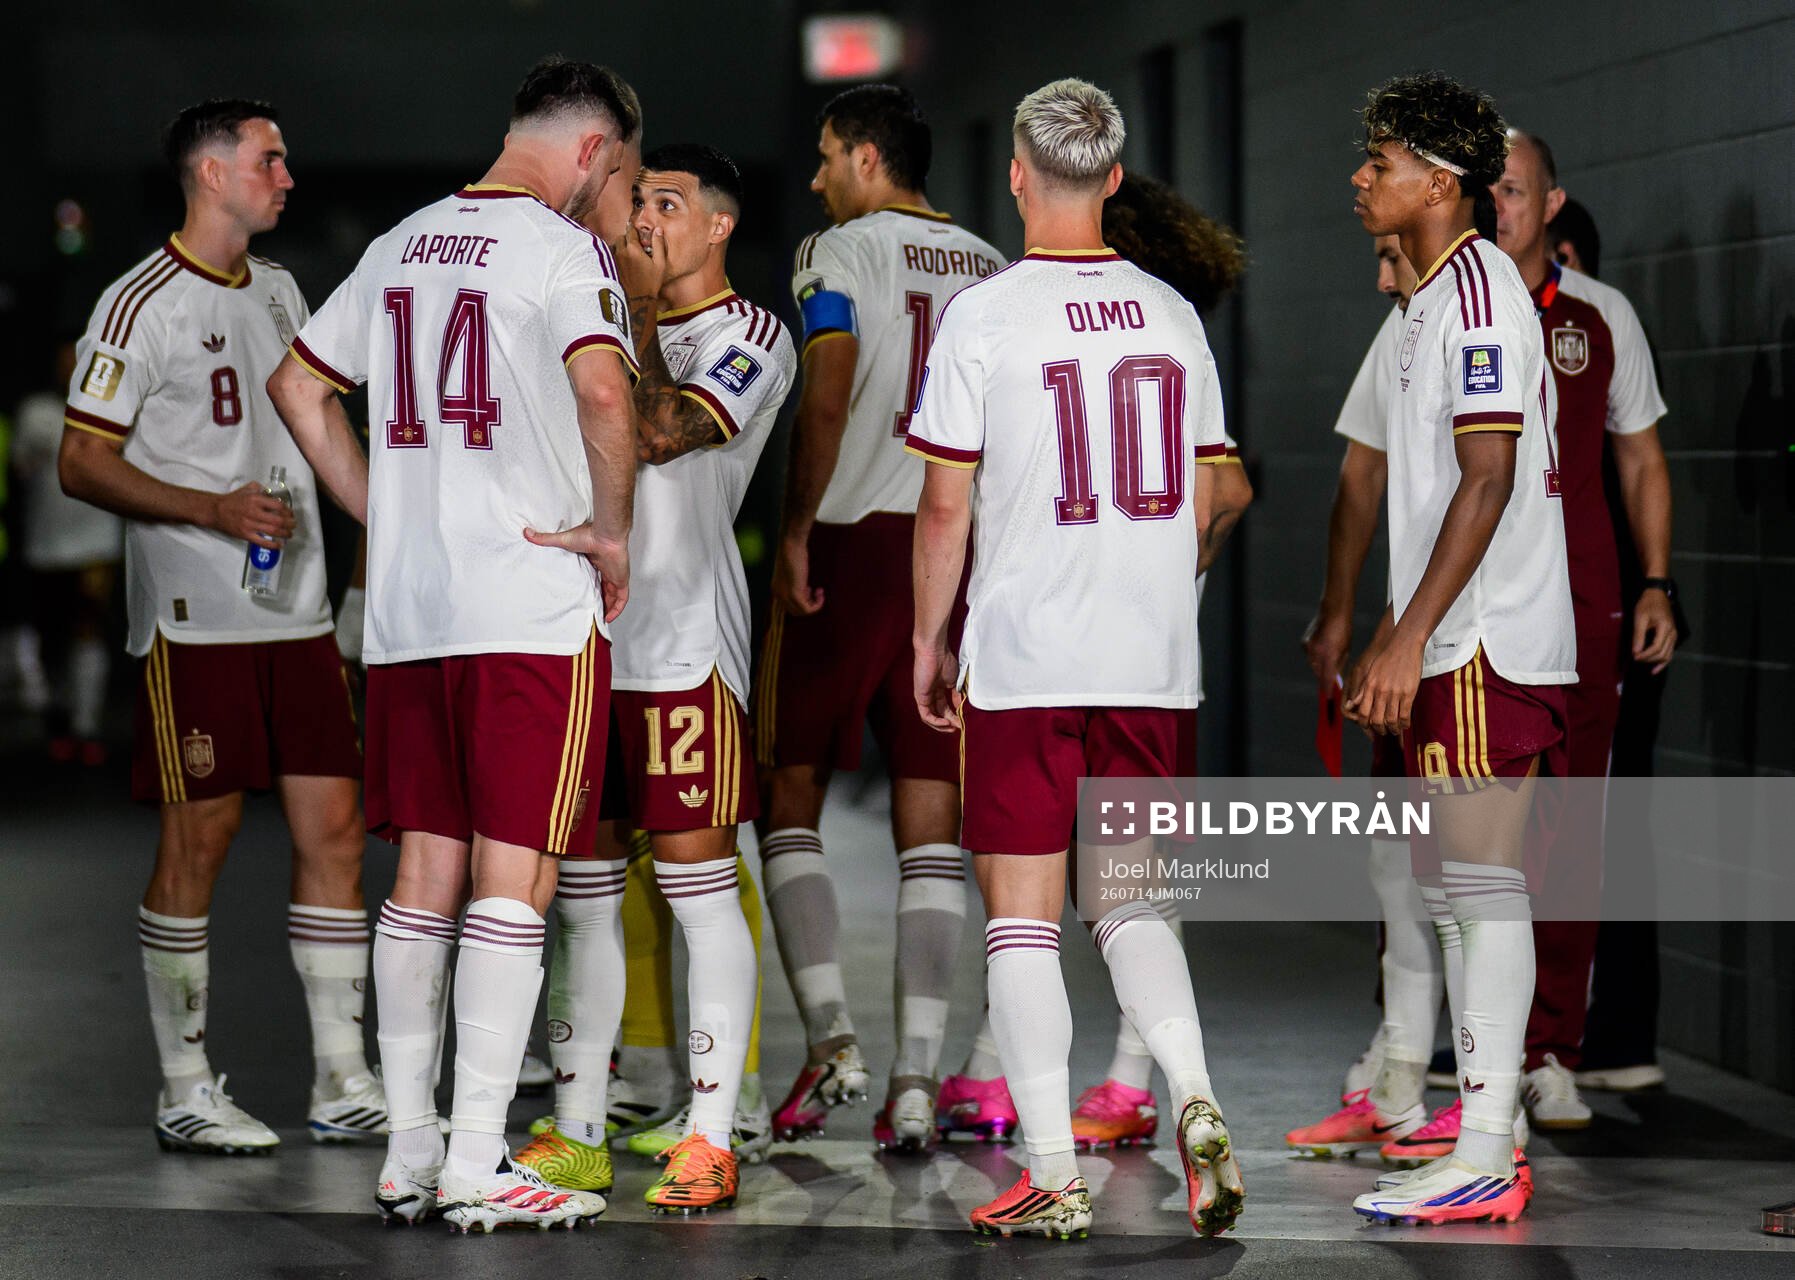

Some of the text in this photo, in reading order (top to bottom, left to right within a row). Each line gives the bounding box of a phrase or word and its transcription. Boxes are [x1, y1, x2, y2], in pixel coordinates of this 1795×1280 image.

[400, 234, 498, 268] LAPORTE
[1065, 299, 1146, 333] OLMO
[210, 365, 243, 427] 8
[383, 286, 501, 450] 14
[1468, 375, 1496, 385] EDUCATION
[1042, 353, 1186, 526] 10
[644, 705, 705, 775] 12
[1417, 741, 1455, 795] 9
